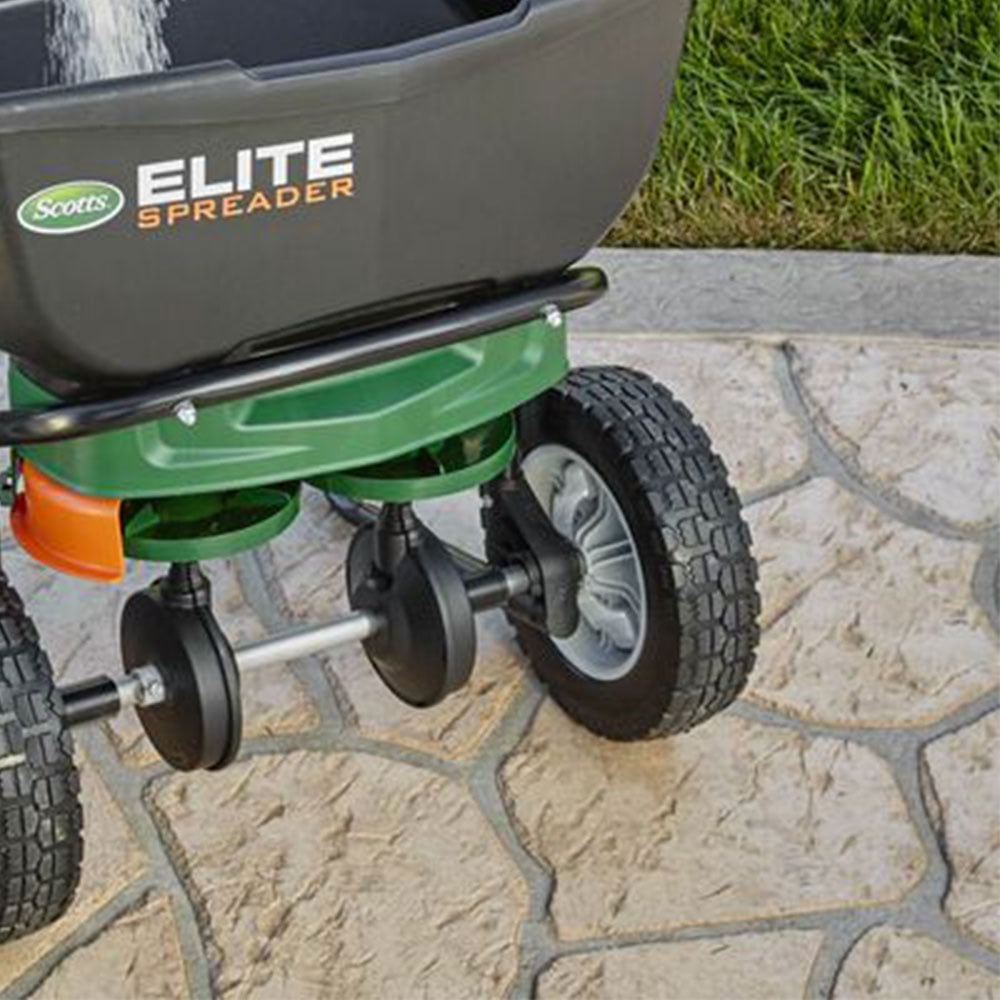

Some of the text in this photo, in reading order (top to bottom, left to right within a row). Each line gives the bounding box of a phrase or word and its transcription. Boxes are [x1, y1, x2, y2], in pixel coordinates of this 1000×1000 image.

[137, 133, 355, 206] ELITE
[33, 193, 108, 220] Scotts
[137, 177, 354, 229] SPREADER
